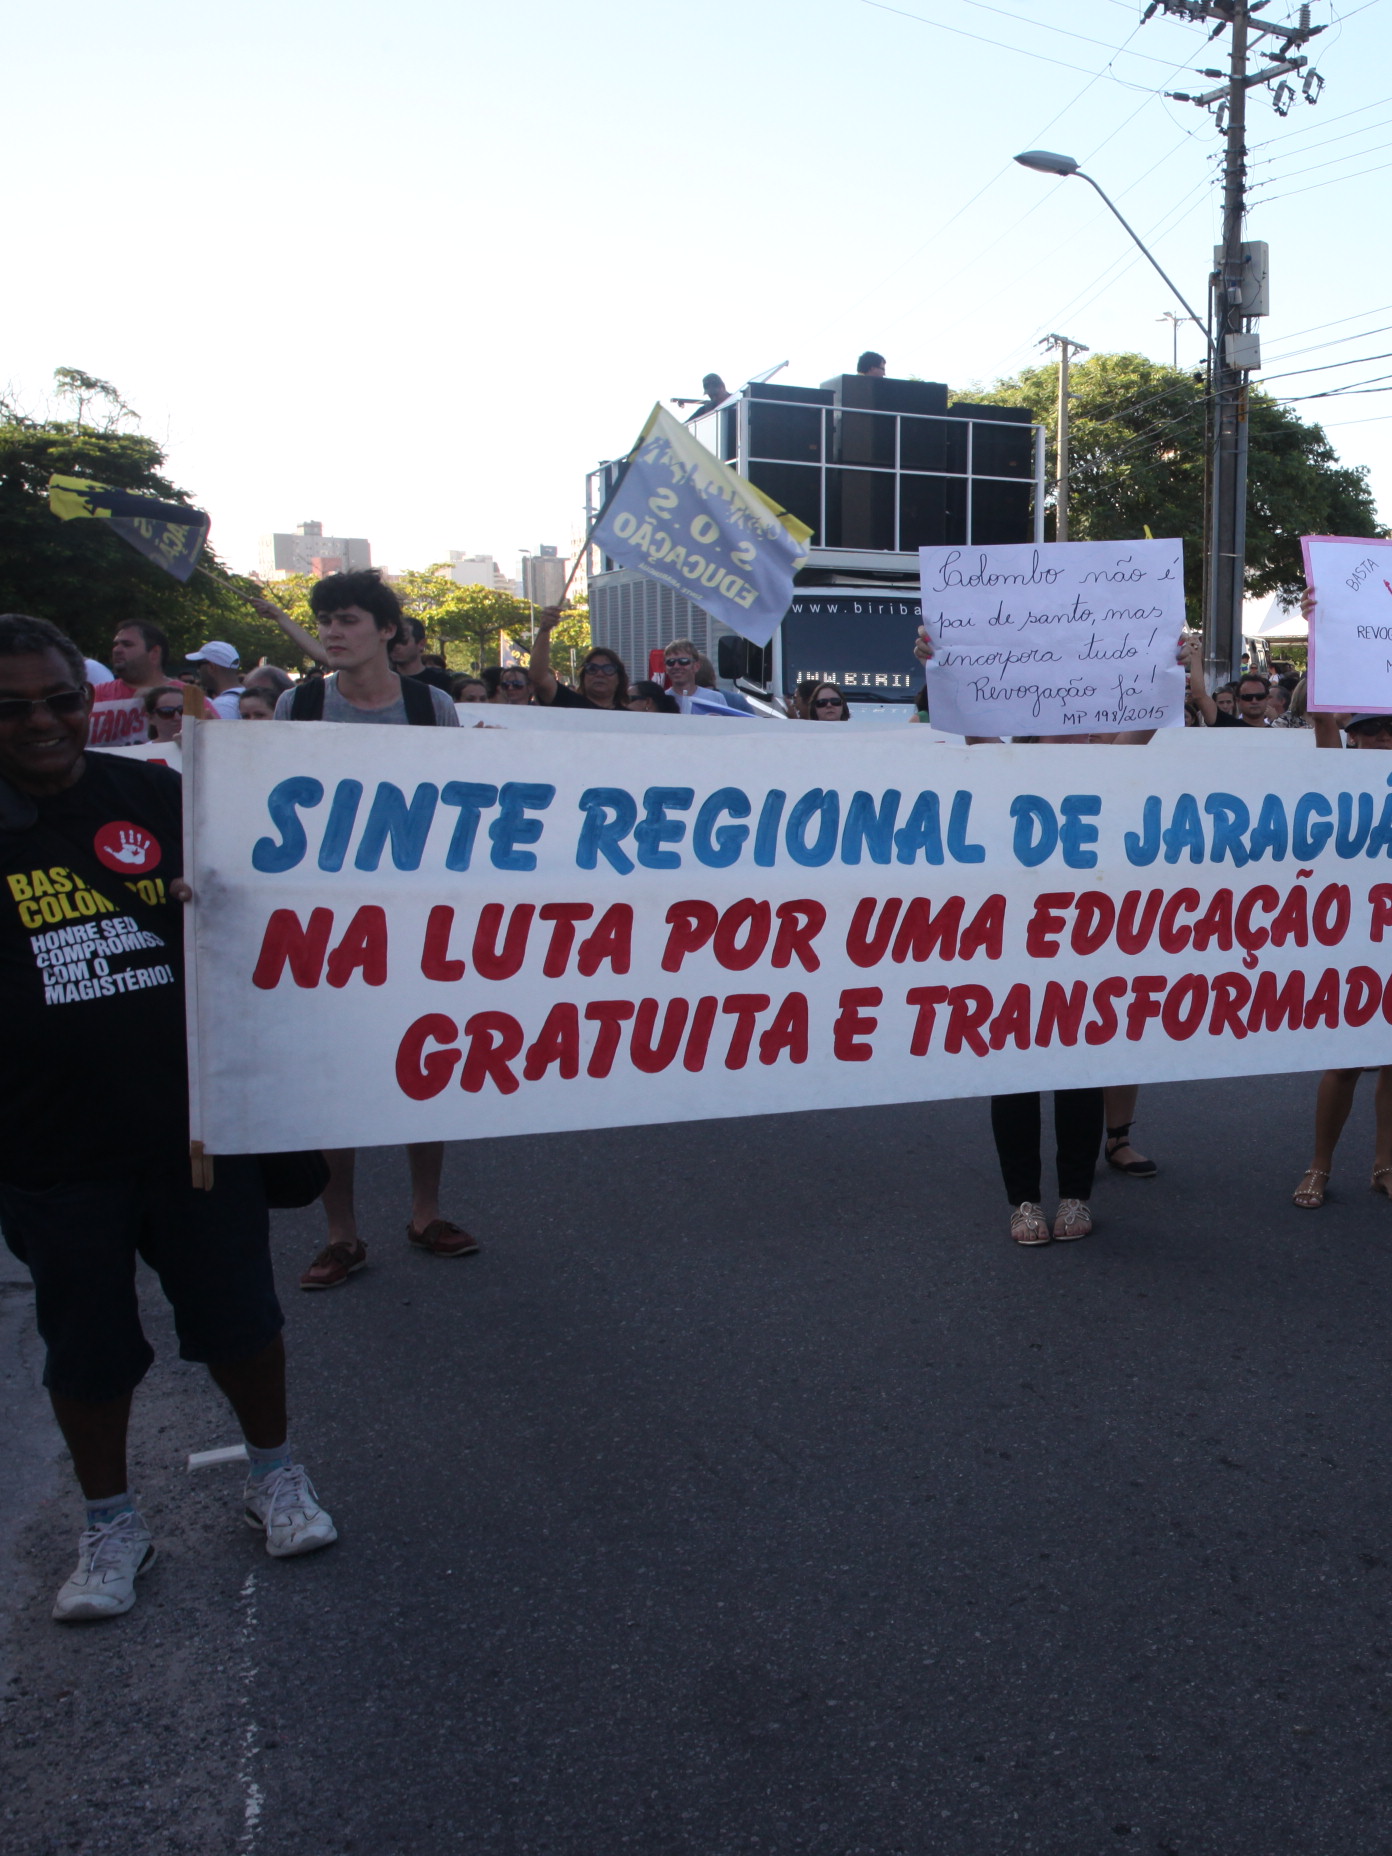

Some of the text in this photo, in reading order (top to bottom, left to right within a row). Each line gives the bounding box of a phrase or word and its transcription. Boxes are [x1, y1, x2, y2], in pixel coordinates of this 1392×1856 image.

[932, 549, 1180, 592] Colombo não é
[1345, 558, 1380, 592] BASTA
[932, 593, 1163, 638] pai de santo, mas
[938, 647, 1062, 681] incorpora
[967, 676, 1097, 718] Revogação
[1063, 705, 1168, 725] MP 198/2015
[251, 775, 557, 874] SINTE
[575, 786, 986, 876] REGIONAL
[1009, 794, 1102, 870] DE
[30, 916, 139, 955] HONRE SEU
[251, 904, 388, 990] NA
[420, 902, 634, 982] LUTA
[661, 897, 827, 973] POR
[846, 893, 1007, 969] UMA
[1026, 868, 1352, 970] EDUCAÇÃO
[42, 957, 110, 986] COM O
[44, 963, 175, 1006] MAGISTÉRIO!
[395, 991, 809, 1101] GRATUITA
[833, 986, 884, 1062] E
